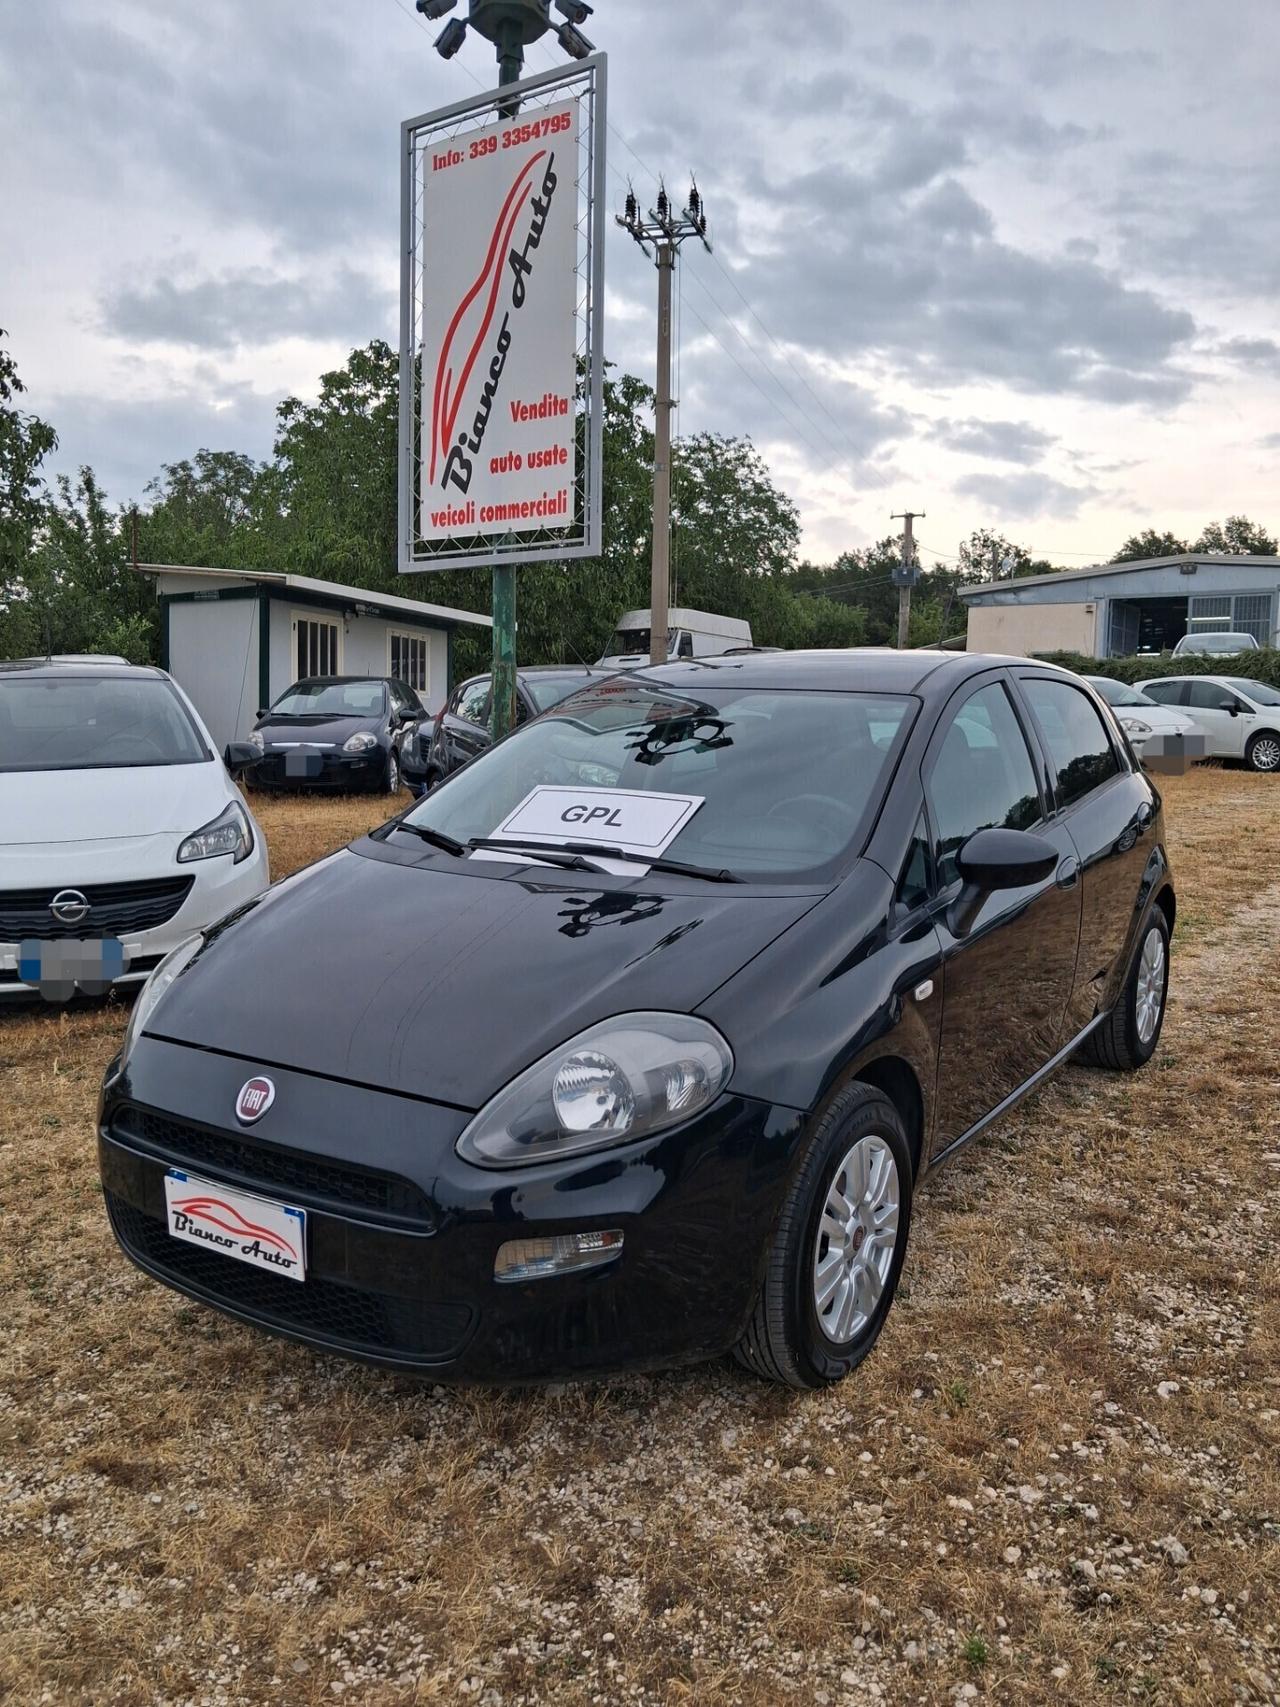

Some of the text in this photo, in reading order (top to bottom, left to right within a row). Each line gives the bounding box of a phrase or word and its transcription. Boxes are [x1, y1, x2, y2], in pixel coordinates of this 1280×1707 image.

[432, 112, 571, 171] Info: 339 3354795
[441, 152, 557, 494] Bianco Auto
[510, 393, 569, 423] Vendita
[489, 443, 568, 474] auto usate
[430, 489, 567, 528] veicoli commerciali
[560, 805, 622, 827] GPL
[243, 1088, 266, 1110] FIAT
[172, 1210, 297, 1268] Bianco Auto
